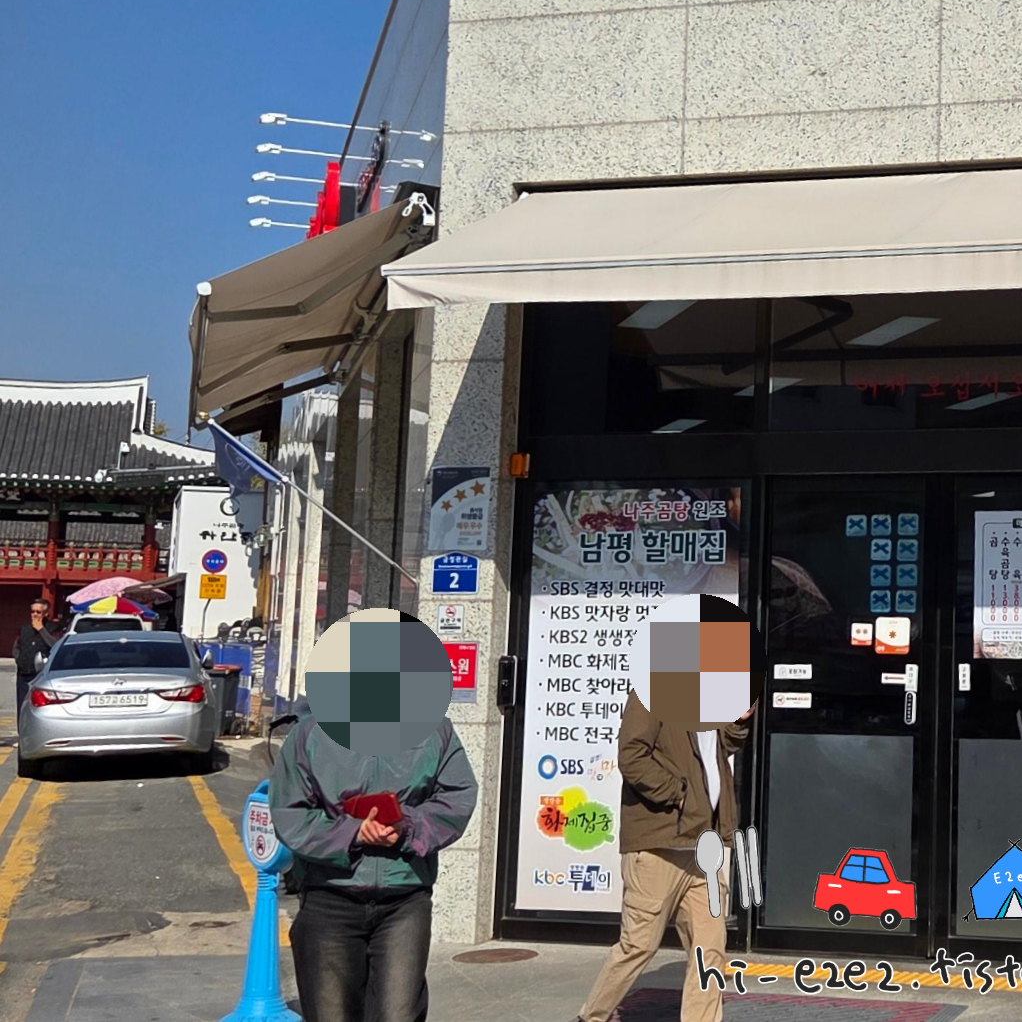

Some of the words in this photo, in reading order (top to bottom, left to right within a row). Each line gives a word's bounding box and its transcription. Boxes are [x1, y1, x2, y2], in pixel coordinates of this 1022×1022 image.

[623, 502, 690, 522] 나주곰탕
[692, 500, 727, 519] 원조
[579, 530, 633, 565] 남평
[641, 529, 727, 566] 할매집
[449, 572, 460, 588] 2
[550, 582, 579, 596] SBS
[584, 581, 614, 598] 결정
[618, 581, 666, 598] 맛대맛
[549, 606, 580, 620] KBS
[584, 605, 631, 622] 맛자랑
[548, 630, 588, 645] KBS2
[547, 654, 582, 668] MBC
[546, 678, 581, 692] MBC
[545, 702, 576, 717] KBC
[544, 727, 579, 742] MBC
[560, 758, 585, 776] SBS
[541, 807, 612, 833] 화제집중
[534, 869, 565, 884] kbc
